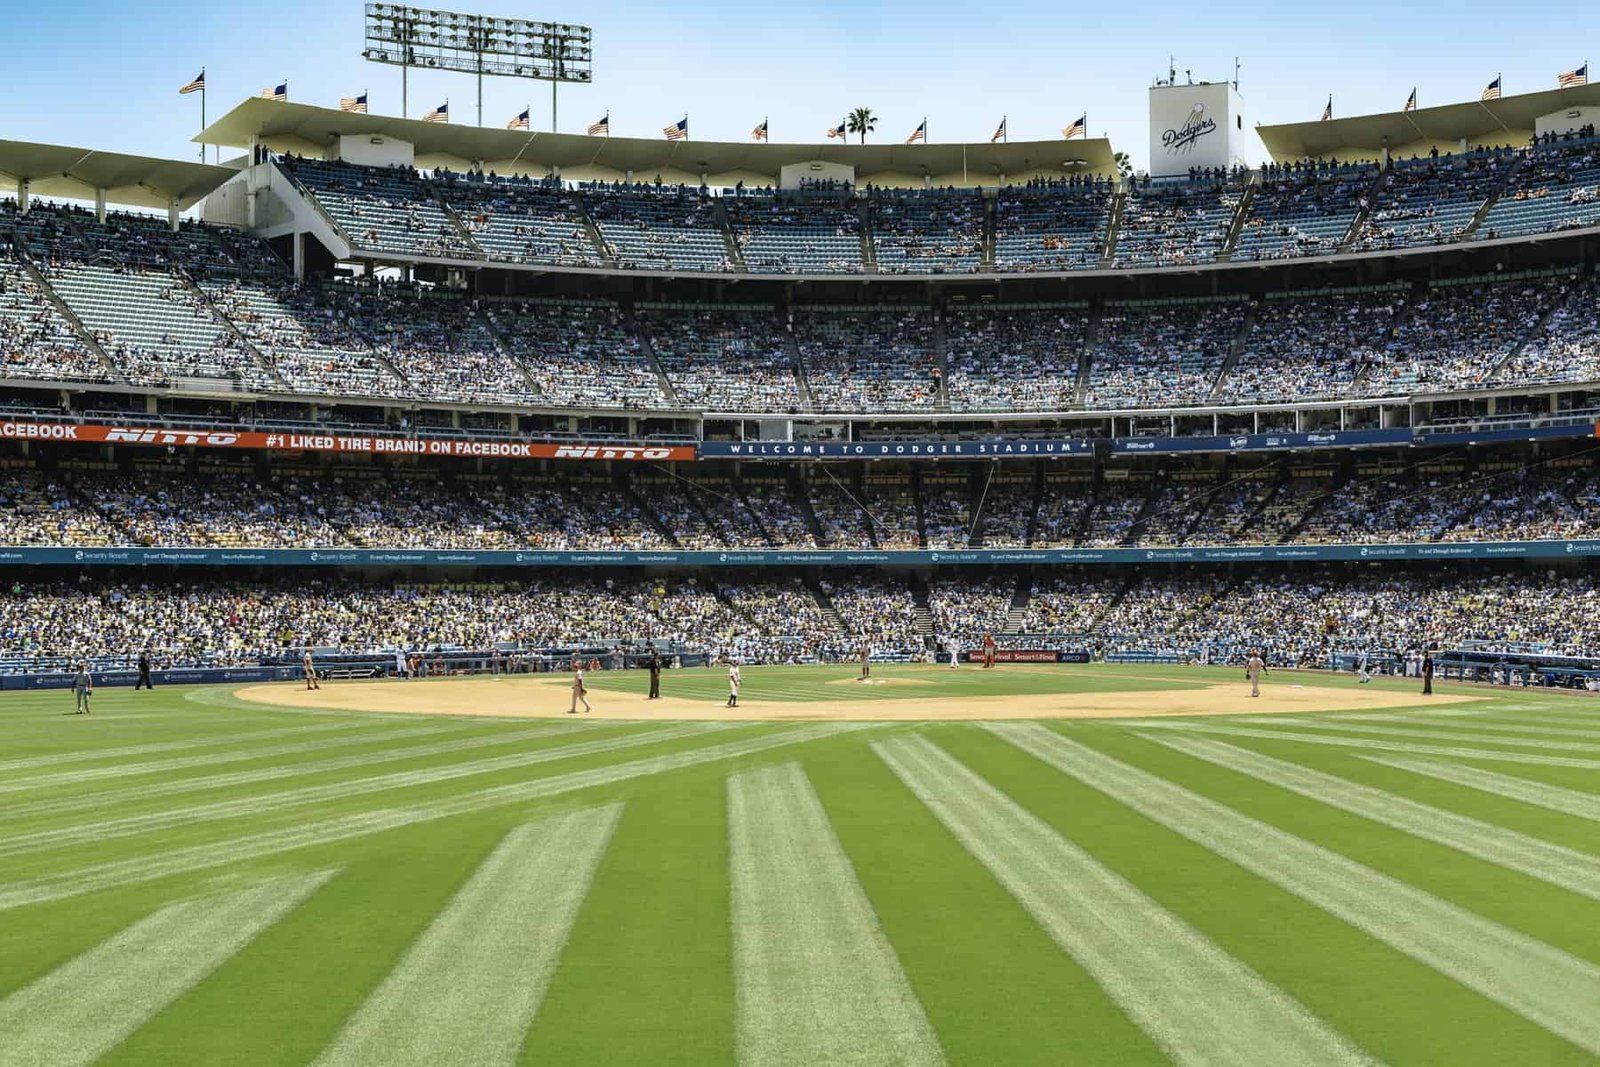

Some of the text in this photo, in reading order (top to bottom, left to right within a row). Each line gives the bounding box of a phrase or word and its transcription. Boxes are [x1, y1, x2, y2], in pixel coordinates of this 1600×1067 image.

[1162, 118, 1216, 147] Dodgers
[0, 422, 77, 438] CEBOOK
[105, 428, 238, 445] NITTO
[266, 435, 531, 456] #1 LIKED TIRE BRAND ON FACEBOOK
[555, 446, 672, 460] NITTO
[730, 443, 1071, 455] WELCOME TO DODGER STADIUM
